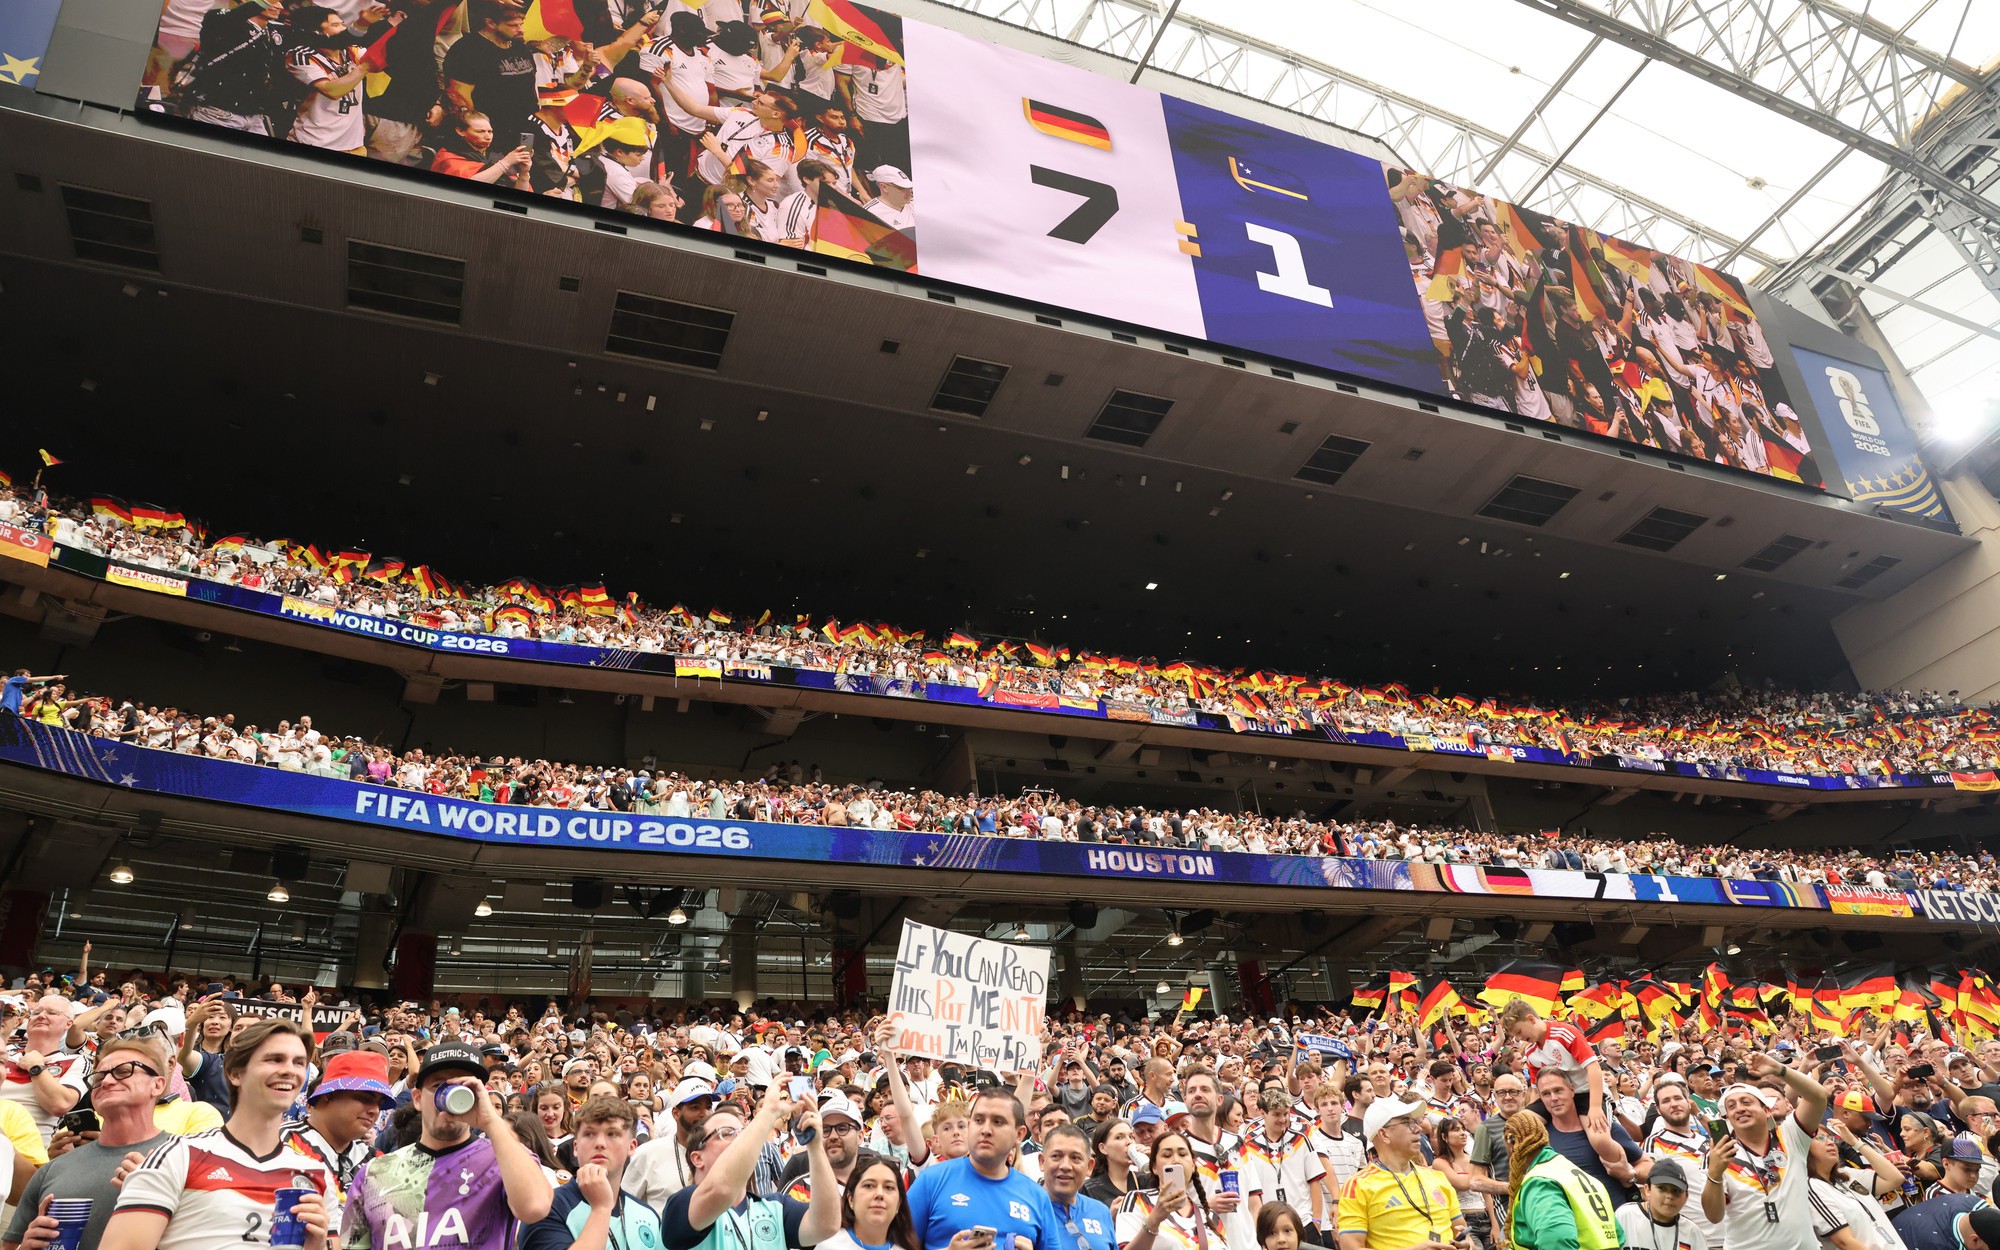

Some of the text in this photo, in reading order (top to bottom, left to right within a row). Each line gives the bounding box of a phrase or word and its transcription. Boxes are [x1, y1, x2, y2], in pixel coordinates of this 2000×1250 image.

[1030, 164, 1119, 245] 7
[1245, 222, 1334, 309] 1
[1854, 419, 1871, 429] FIFA
[1850, 432, 1886, 446] WORLD CUP
[1854, 440, 1891, 457] 2026
[329, 612, 398, 637] WORLD
[400, 627, 439, 646] CUP
[441, 635, 509, 653] 2026
[1247, 720, 1293, 735] USTON
[355, 790, 750, 849] FIFA WORLD CUP 2026
[1087, 850, 1215, 876] HOUSTON
[1585, 872, 1607, 899] 7
[1652, 875, 1679, 902] 1
[1826, 884, 1904, 901] BAD WALDSEE
[964, 940, 998, 987] CAN
[999, 946, 1044, 995] READ
[968, 985, 1000, 1029] ME
[1000, 997, 1020, 1032] ON
[1021, 996, 1044, 1036] TV
[430, 1049, 462, 1061] ELECTRIC
[207, 1174, 233, 1182] adidas
[1009, 1200, 1030, 1222] ES
[383, 1207, 469, 1250] AIA
[1082, 1218, 1103, 1235] ES
